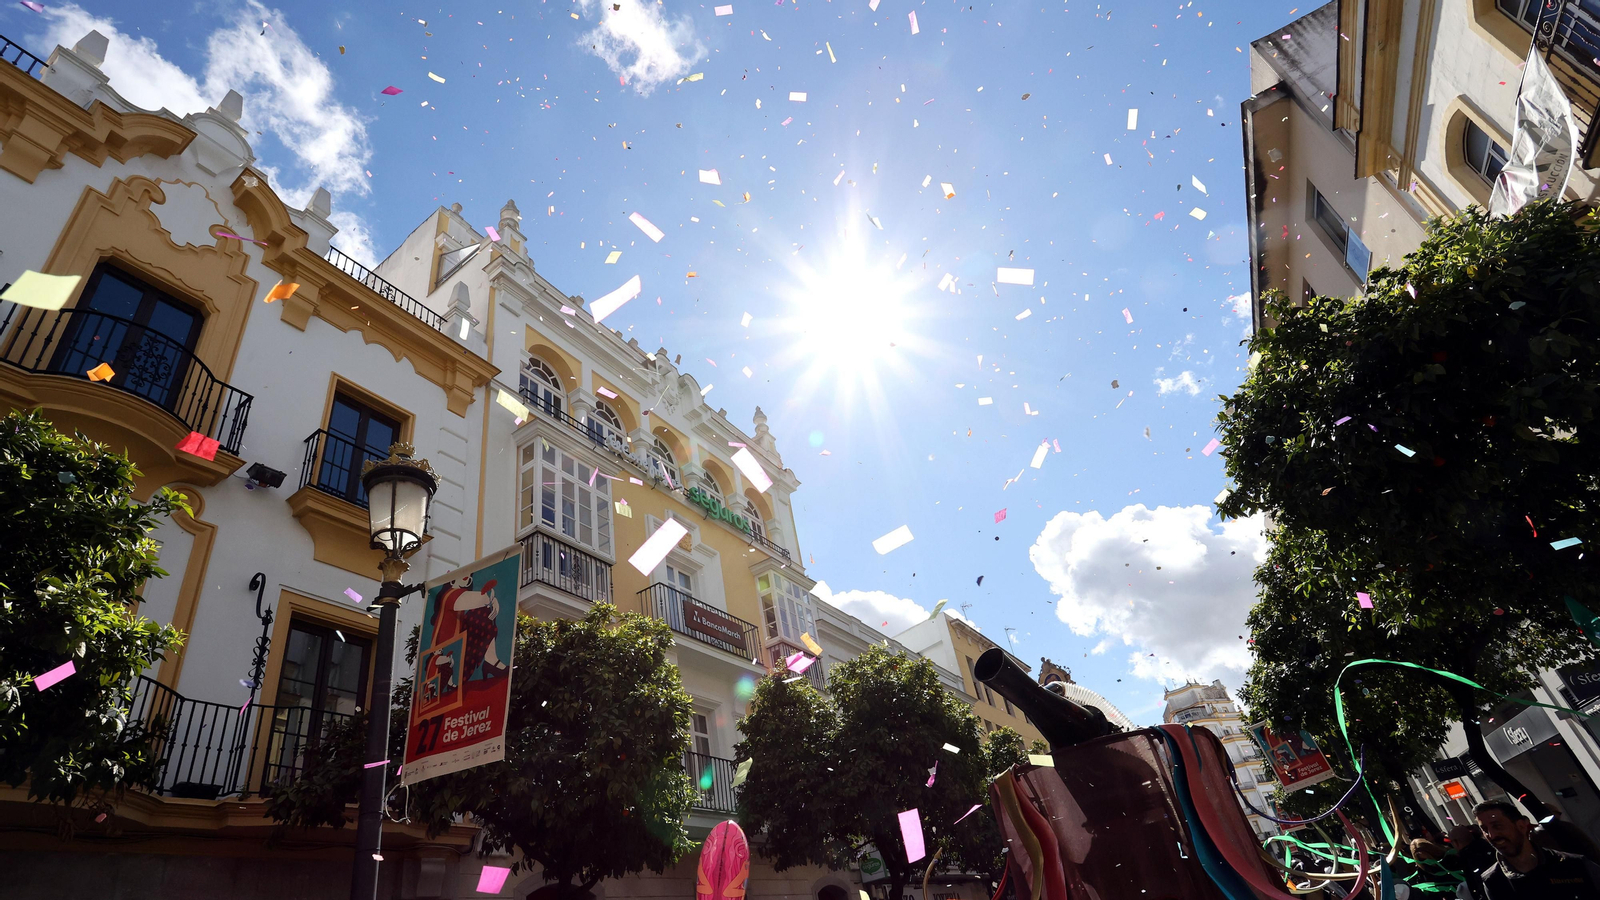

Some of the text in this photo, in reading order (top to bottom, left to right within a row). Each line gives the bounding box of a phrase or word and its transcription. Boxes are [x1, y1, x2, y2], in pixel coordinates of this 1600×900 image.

[1537, 153, 1569, 199] STRUCCIÓN
[689, 486, 751, 534] seguros
[702, 617, 741, 640] BancaMarch
[444, 706, 490, 730] Festival
[415, 714, 444, 755] 27
[442, 729, 459, 743] de
[461, 720, 492, 739] Jerez
[1297, 761, 1319, 773] Festival
[1308, 765, 1323, 774] Jerez
